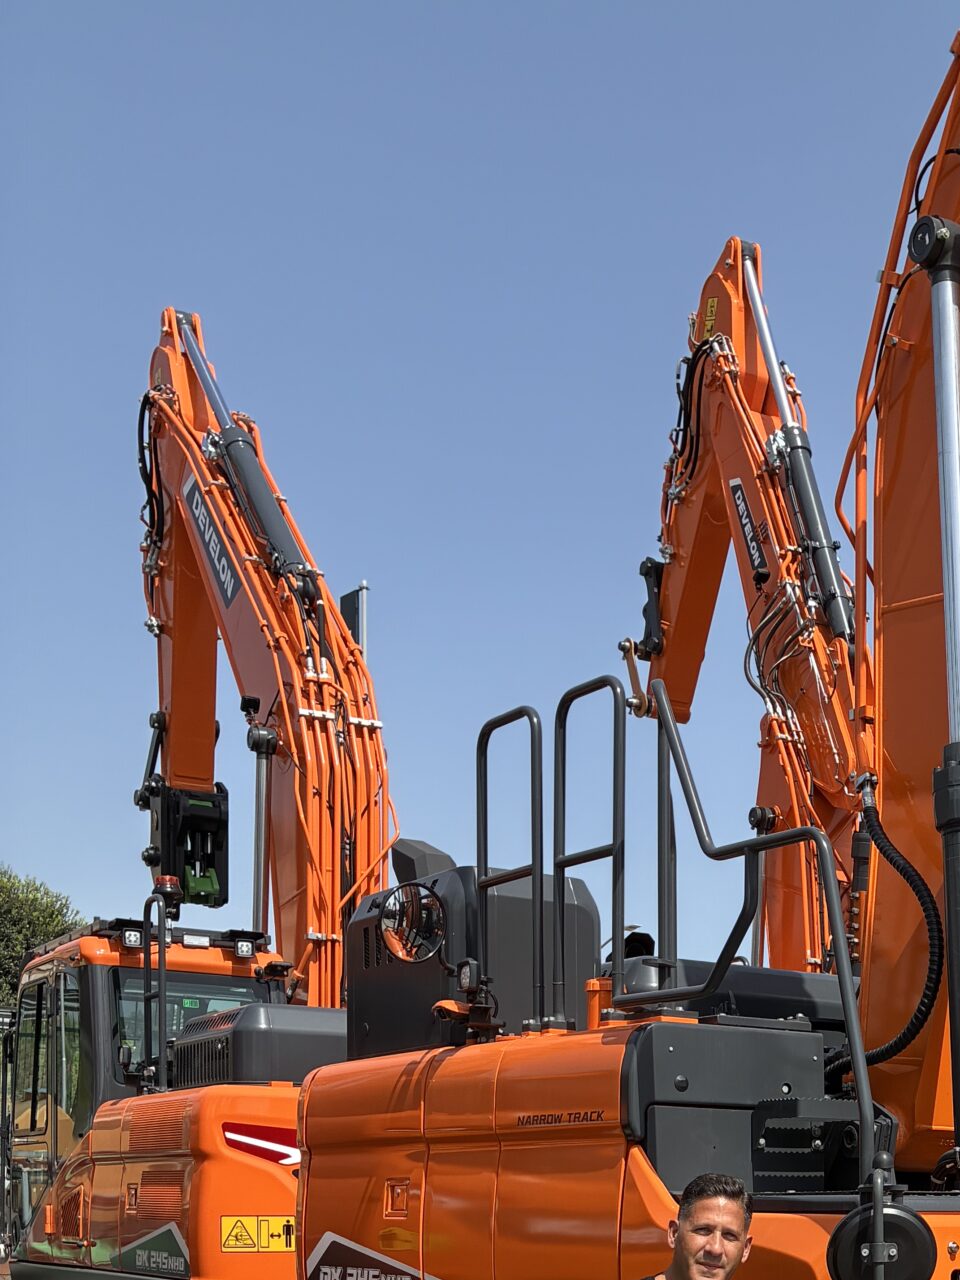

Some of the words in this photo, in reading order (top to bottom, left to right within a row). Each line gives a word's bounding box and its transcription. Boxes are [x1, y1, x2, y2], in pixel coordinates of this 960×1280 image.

[191, 489, 235, 600] DEVELON
[735, 488, 762, 567] DEVELON
[517, 1113, 563, 1126] NARROW
[567, 1110, 605, 1122] TRACK
